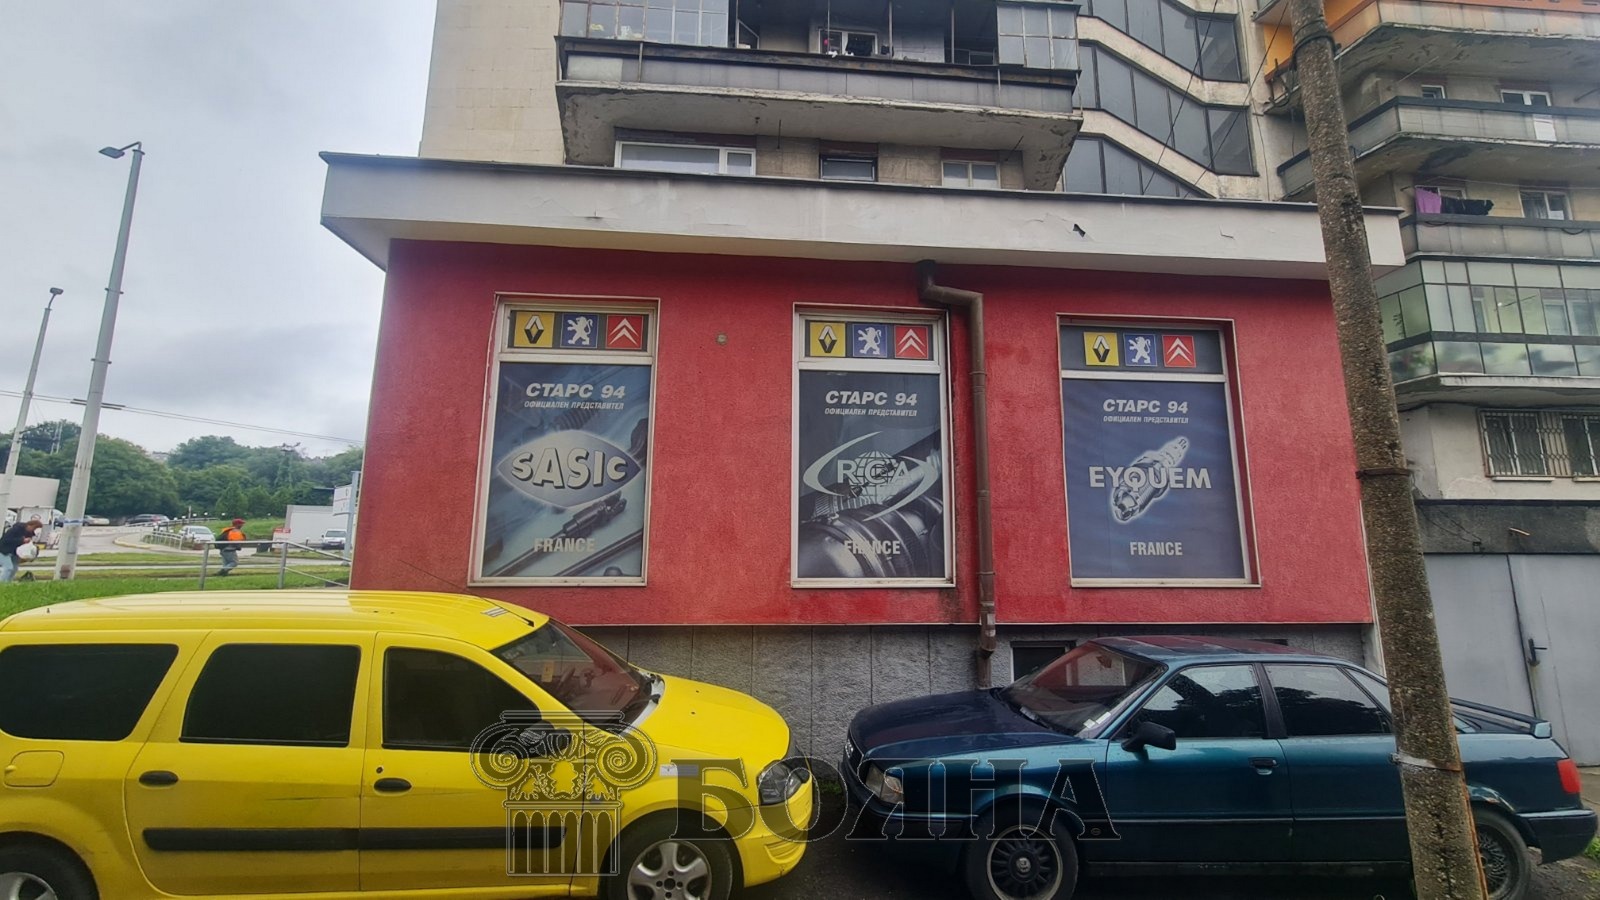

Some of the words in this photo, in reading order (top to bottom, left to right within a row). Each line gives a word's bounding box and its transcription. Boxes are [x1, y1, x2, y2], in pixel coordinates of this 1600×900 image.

[525, 382, 594, 399] СТАРС
[600, 383, 626, 399] 94
[825, 390, 888, 405] СТАРС
[895, 392, 918, 406] 94
[524, 400, 569, 409] ОФИЦИАЛЕН
[571, 401, 624, 410] ПРЕДСТАВИТЕЛ
[824, 407, 867, 416] ОФИЦИАЛЕН
[868, 408, 917, 417] ПРЕДСТАВИТЕЛ
[1102, 399, 1161, 413] СТАРС
[1167, 400, 1189, 414] 94
[1103, 415, 1142, 423] ОФИЦИАЛЕН
[1143, 416, 1189, 424] ПРЕДСТАВИТЕЛ
[511, 447, 629, 489] SASIC
[837, 458, 912, 485] RCA
[1088, 466, 1212, 492] EYQUEM
[533, 537, 595, 553] FRANCE
[843, 539, 901, 555] FRANCE
[1129, 541, 1183, 556] FRANCE
